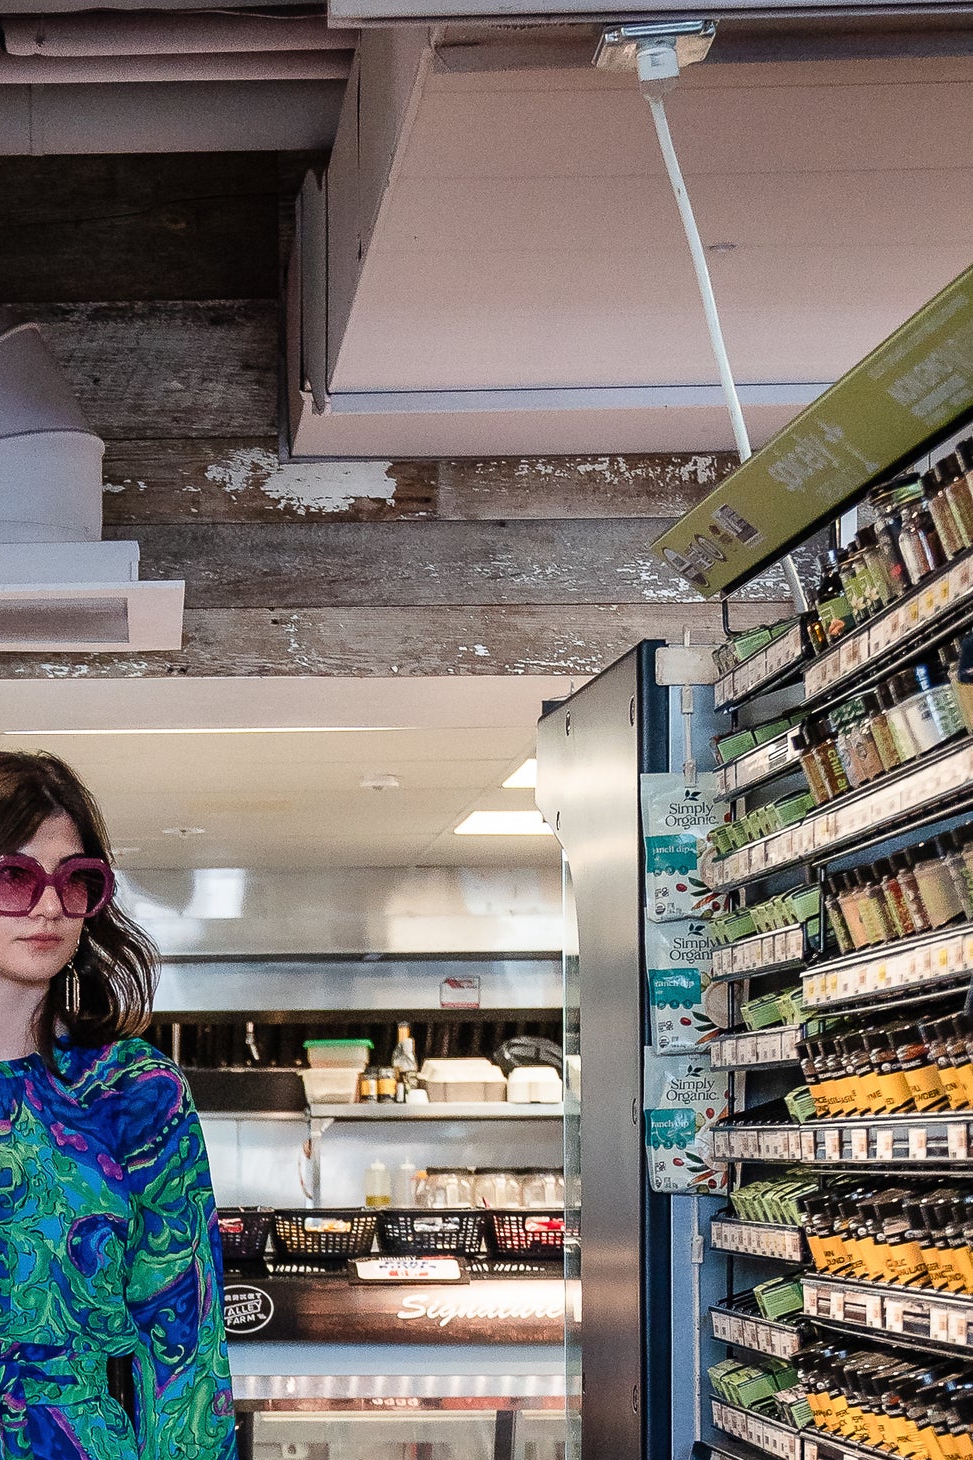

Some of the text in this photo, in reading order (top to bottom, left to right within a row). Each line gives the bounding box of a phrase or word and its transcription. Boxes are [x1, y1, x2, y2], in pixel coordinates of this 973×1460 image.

[669, 803, 715, 822] Simply
[665, 815, 716, 833] Organic
[669, 1078, 716, 1097] Simply
[665, 1089, 717, 1105] Organic
[227, 1314, 256, 1326] FARM
